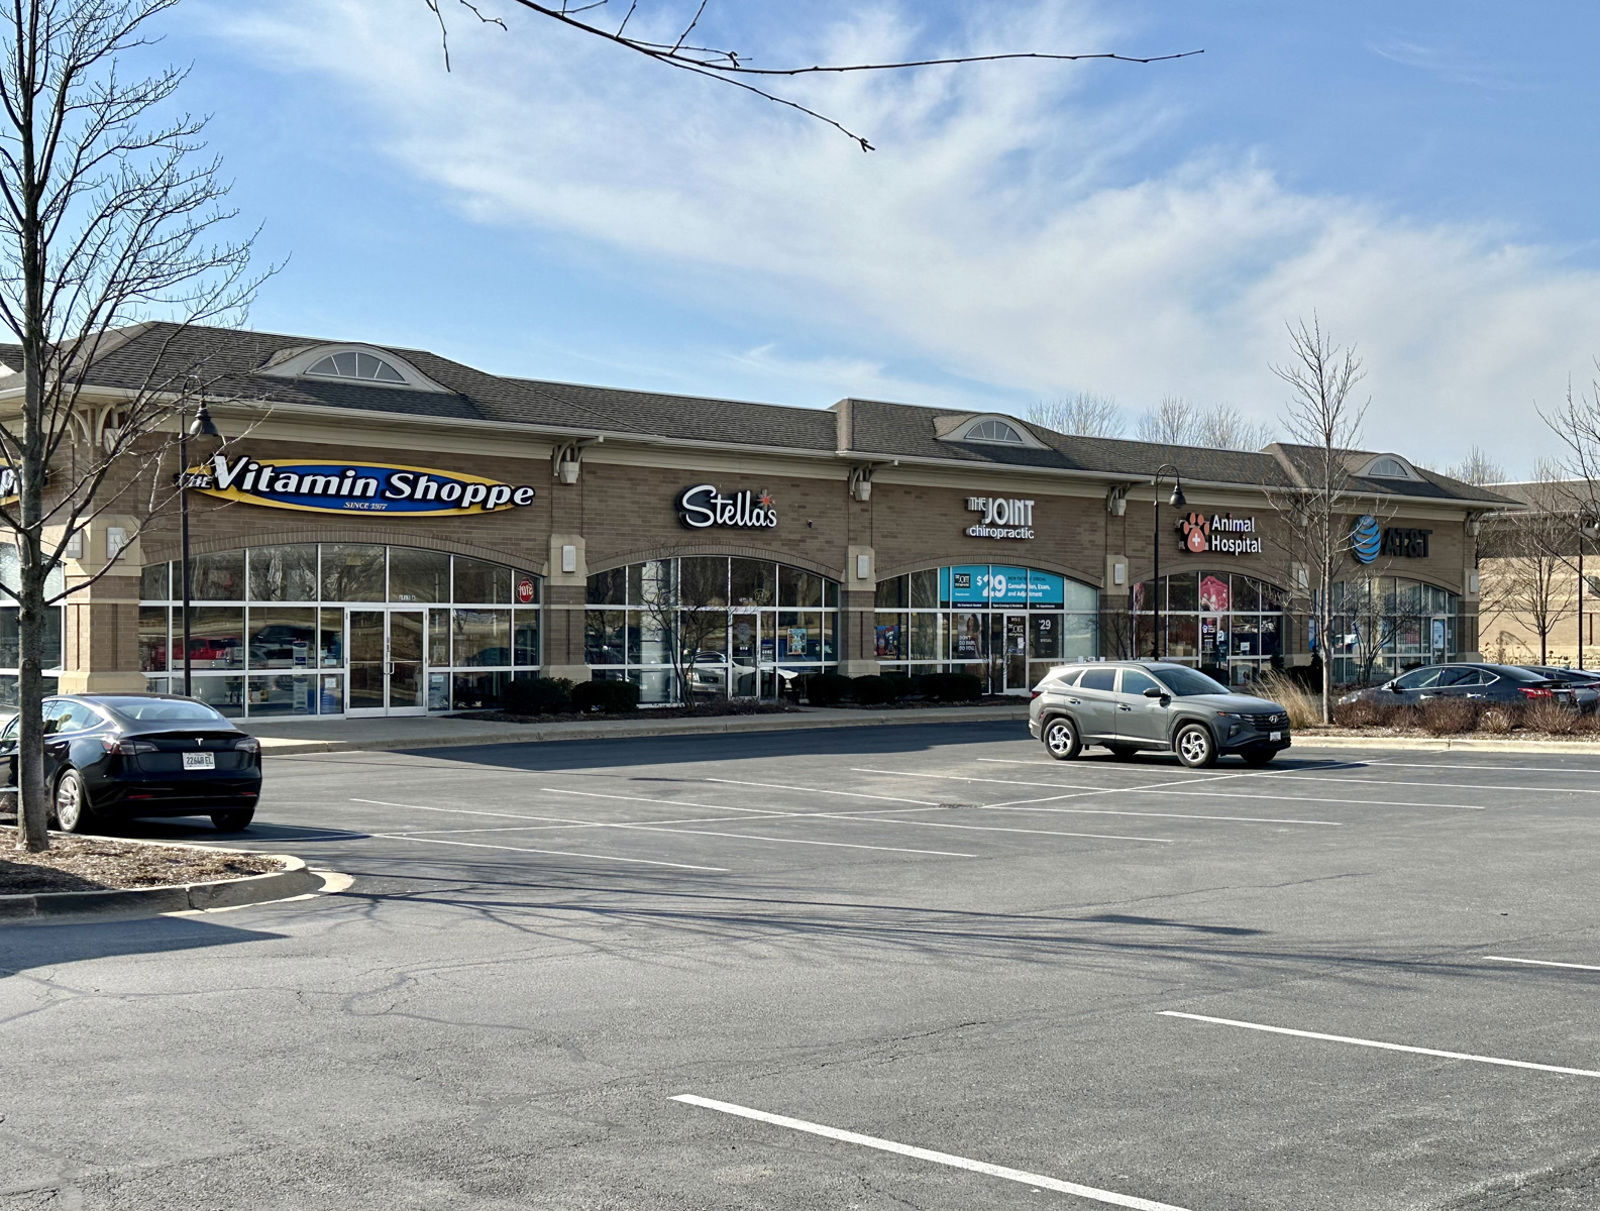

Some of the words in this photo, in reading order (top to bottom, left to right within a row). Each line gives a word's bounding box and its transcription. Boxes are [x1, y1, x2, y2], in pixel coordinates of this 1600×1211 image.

[214, 455, 377, 498] Vitamin
[384, 472, 535, 509] Shoppe
[344, 502, 369, 510] SINCE
[968, 496, 988, 511] THE
[982, 497, 1035, 526] JOINT
[968, 524, 1035, 540] chiropractic
[1211, 513, 1256, 532] Animal
[1211, 533, 1262, 556] Hospital
[1382, 527, 1433, 558] AT&T
[976, 574, 1007, 598] $29
